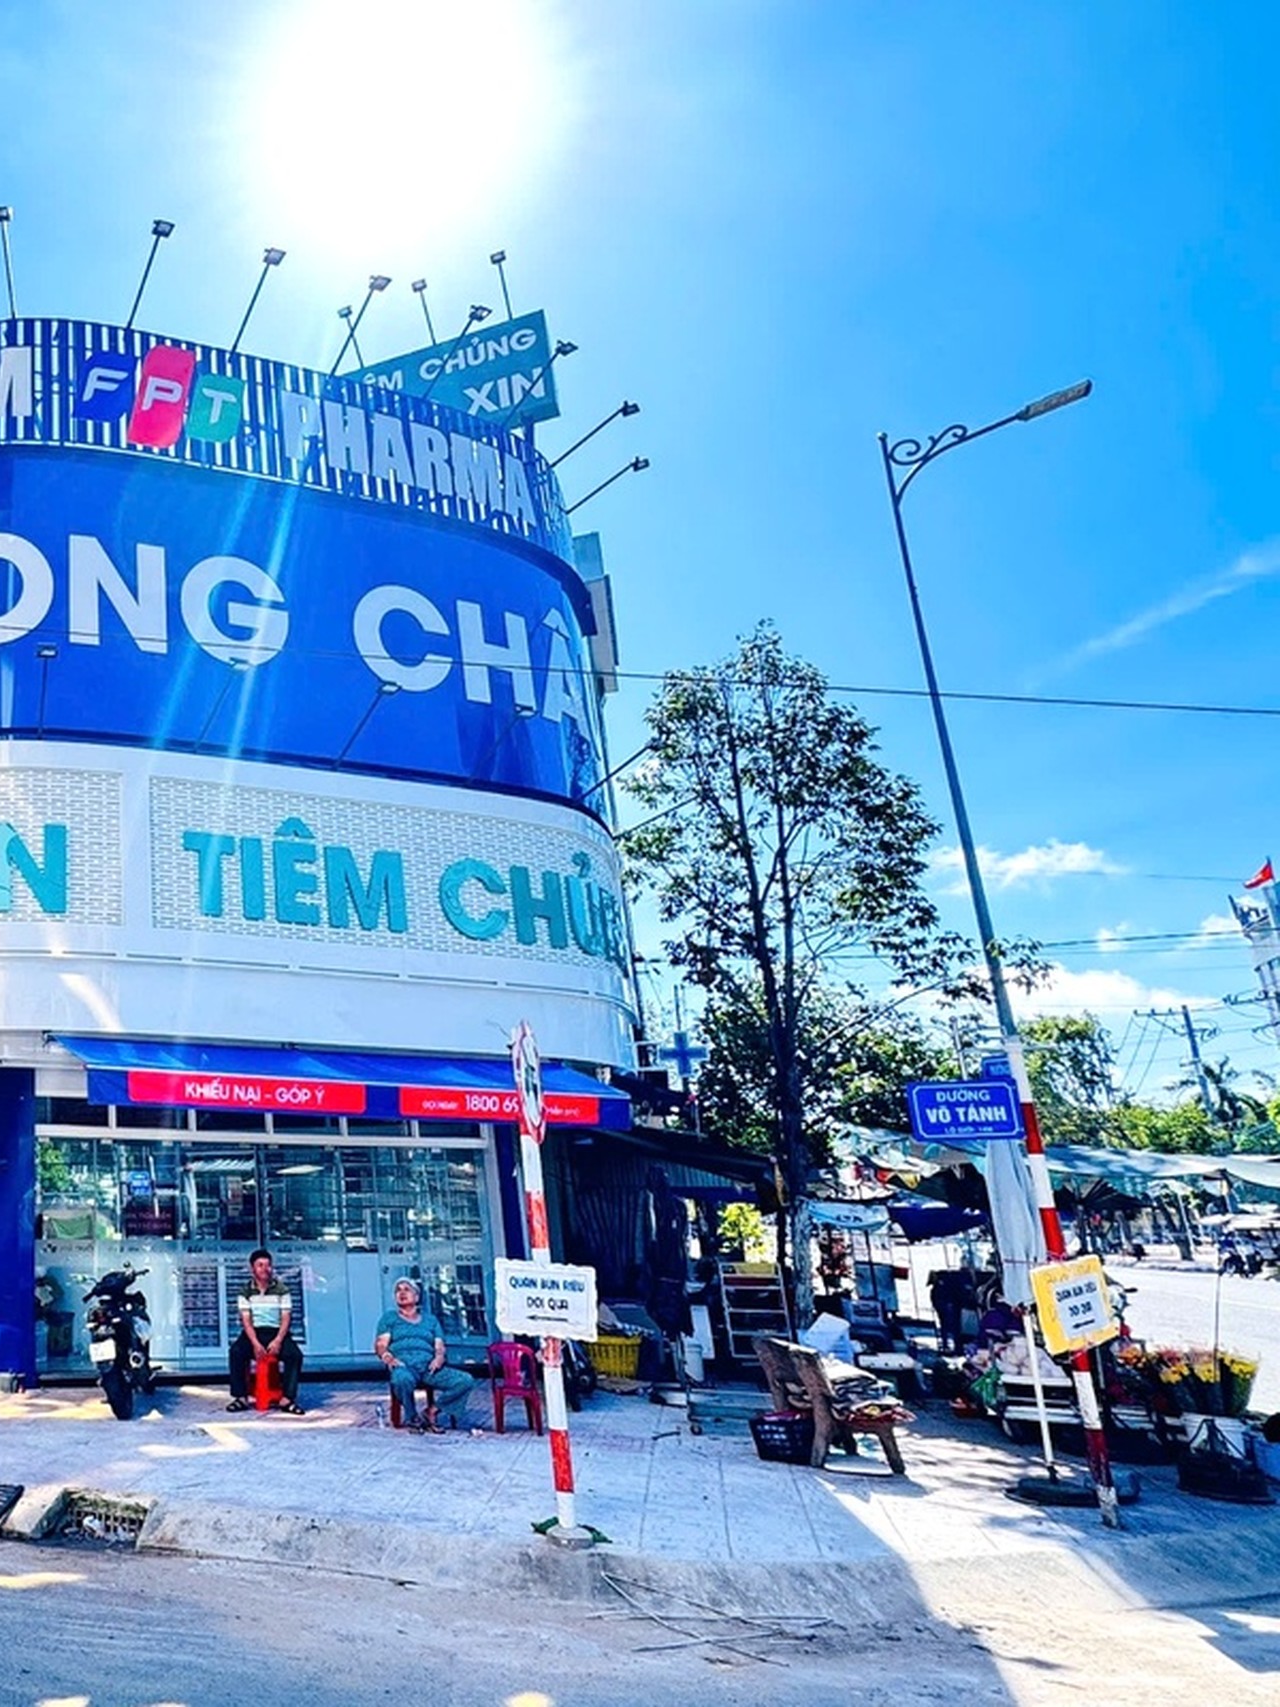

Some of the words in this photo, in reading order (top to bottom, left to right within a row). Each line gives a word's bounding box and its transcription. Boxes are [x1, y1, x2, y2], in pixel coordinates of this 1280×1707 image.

[462, 366, 546, 416] XIN
[280, 389, 538, 529] PHARMA
[182, 816, 408, 935] TIÊM
[184, 1077, 230, 1100] KHIẾU
[233, 1085, 261, 1105] NẠI
[274, 1084, 311, 1104] GÓP
[314, 1084, 325, 1105] Ý
[464, 1094, 500, 1113] 1800
[935, 1086, 991, 1102] ĐƯỜNG
[925, 1103, 952, 1123] VÕ
[955, 1102, 1007, 1122] TÁNH
